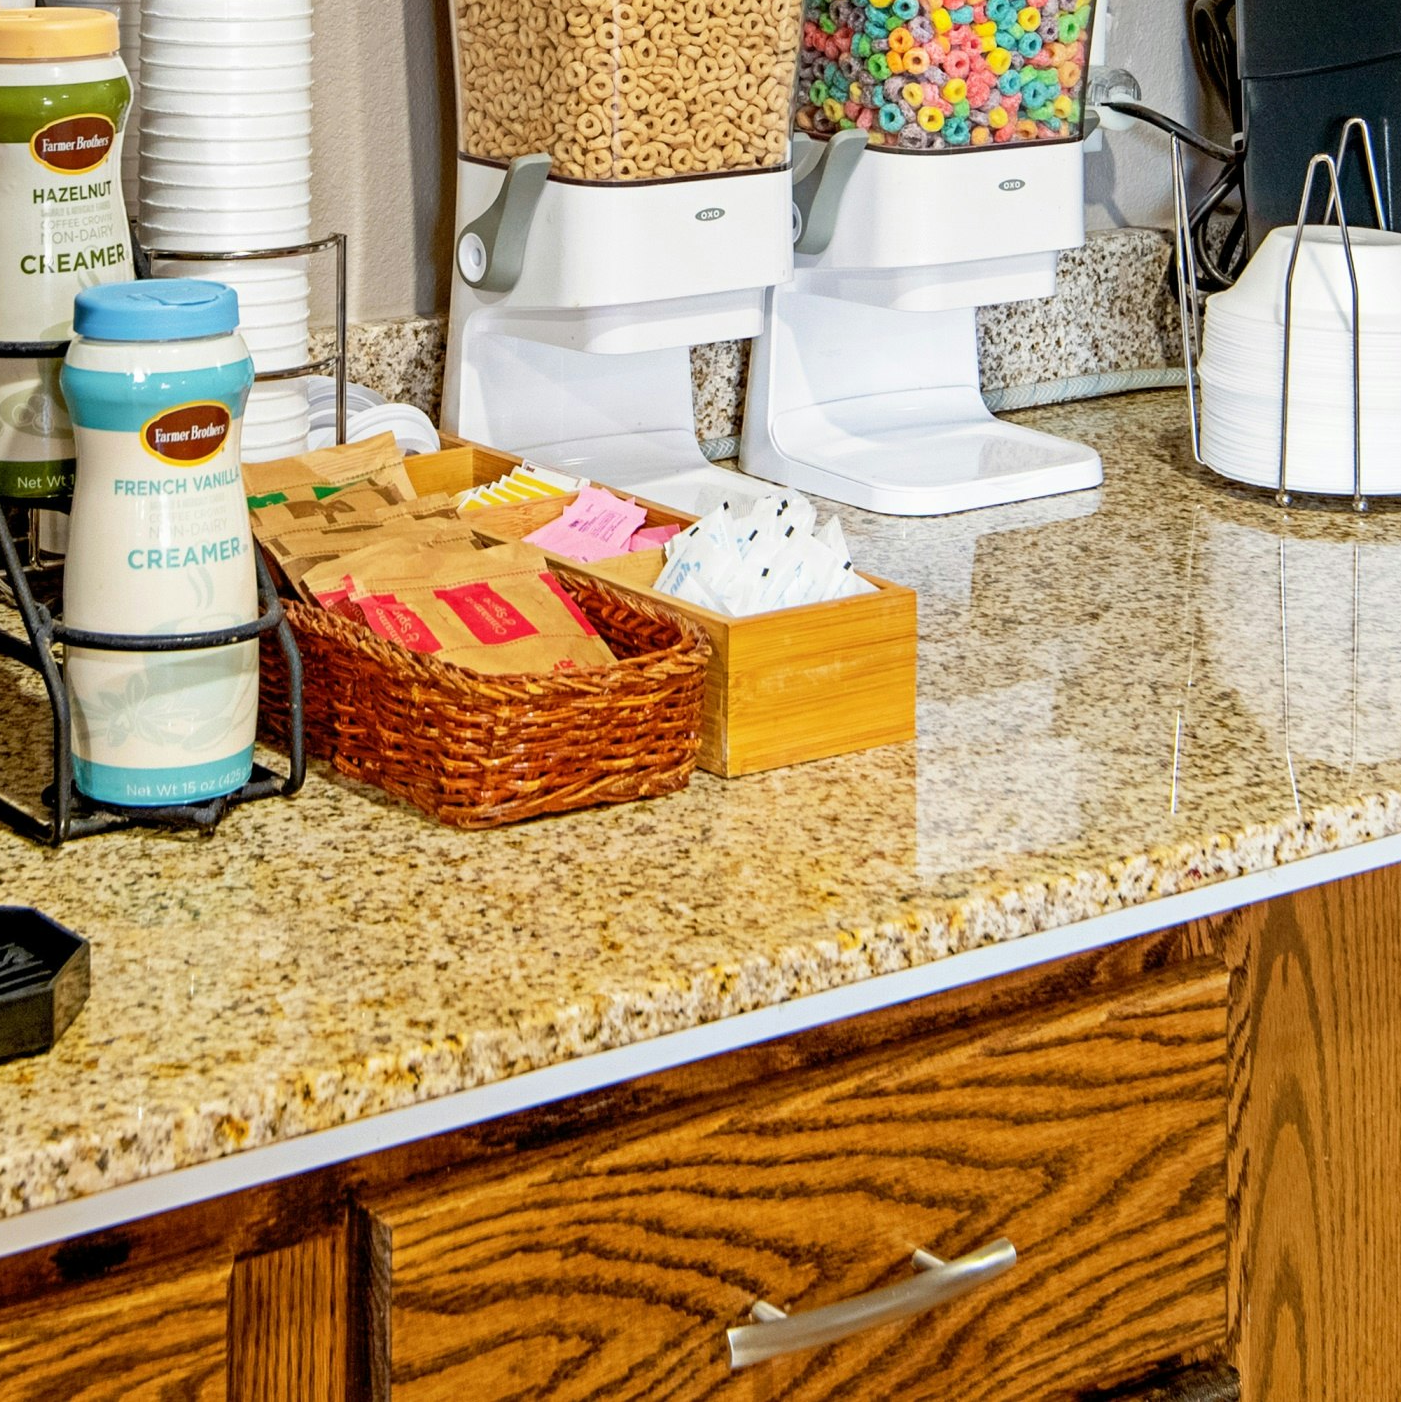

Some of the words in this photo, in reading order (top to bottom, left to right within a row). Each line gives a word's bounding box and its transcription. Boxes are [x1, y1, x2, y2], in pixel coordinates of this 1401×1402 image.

[42, 138, 76, 153] Farmer
[77, 134, 109, 150] Brothers
[33, 181, 112, 204] HAZELNUT
[1002, 179, 1022, 190] OXO
[699, 208, 721, 221] OXO
[20, 243, 126, 275] CREAMER
[155, 428, 190, 443] Farmer
[191, 422, 225, 440] Brothers
[17, 476, 42, 489] Net
[46, 474, 66, 488] Wt
[114, 478, 187, 496] FRENCH
[128, 536, 241, 570] CREAMER
[126, 784, 151, 796] Net
[156, 783, 178, 796] Wt
[183, 781, 196, 794] 15
[200, 780, 215, 792] oz
